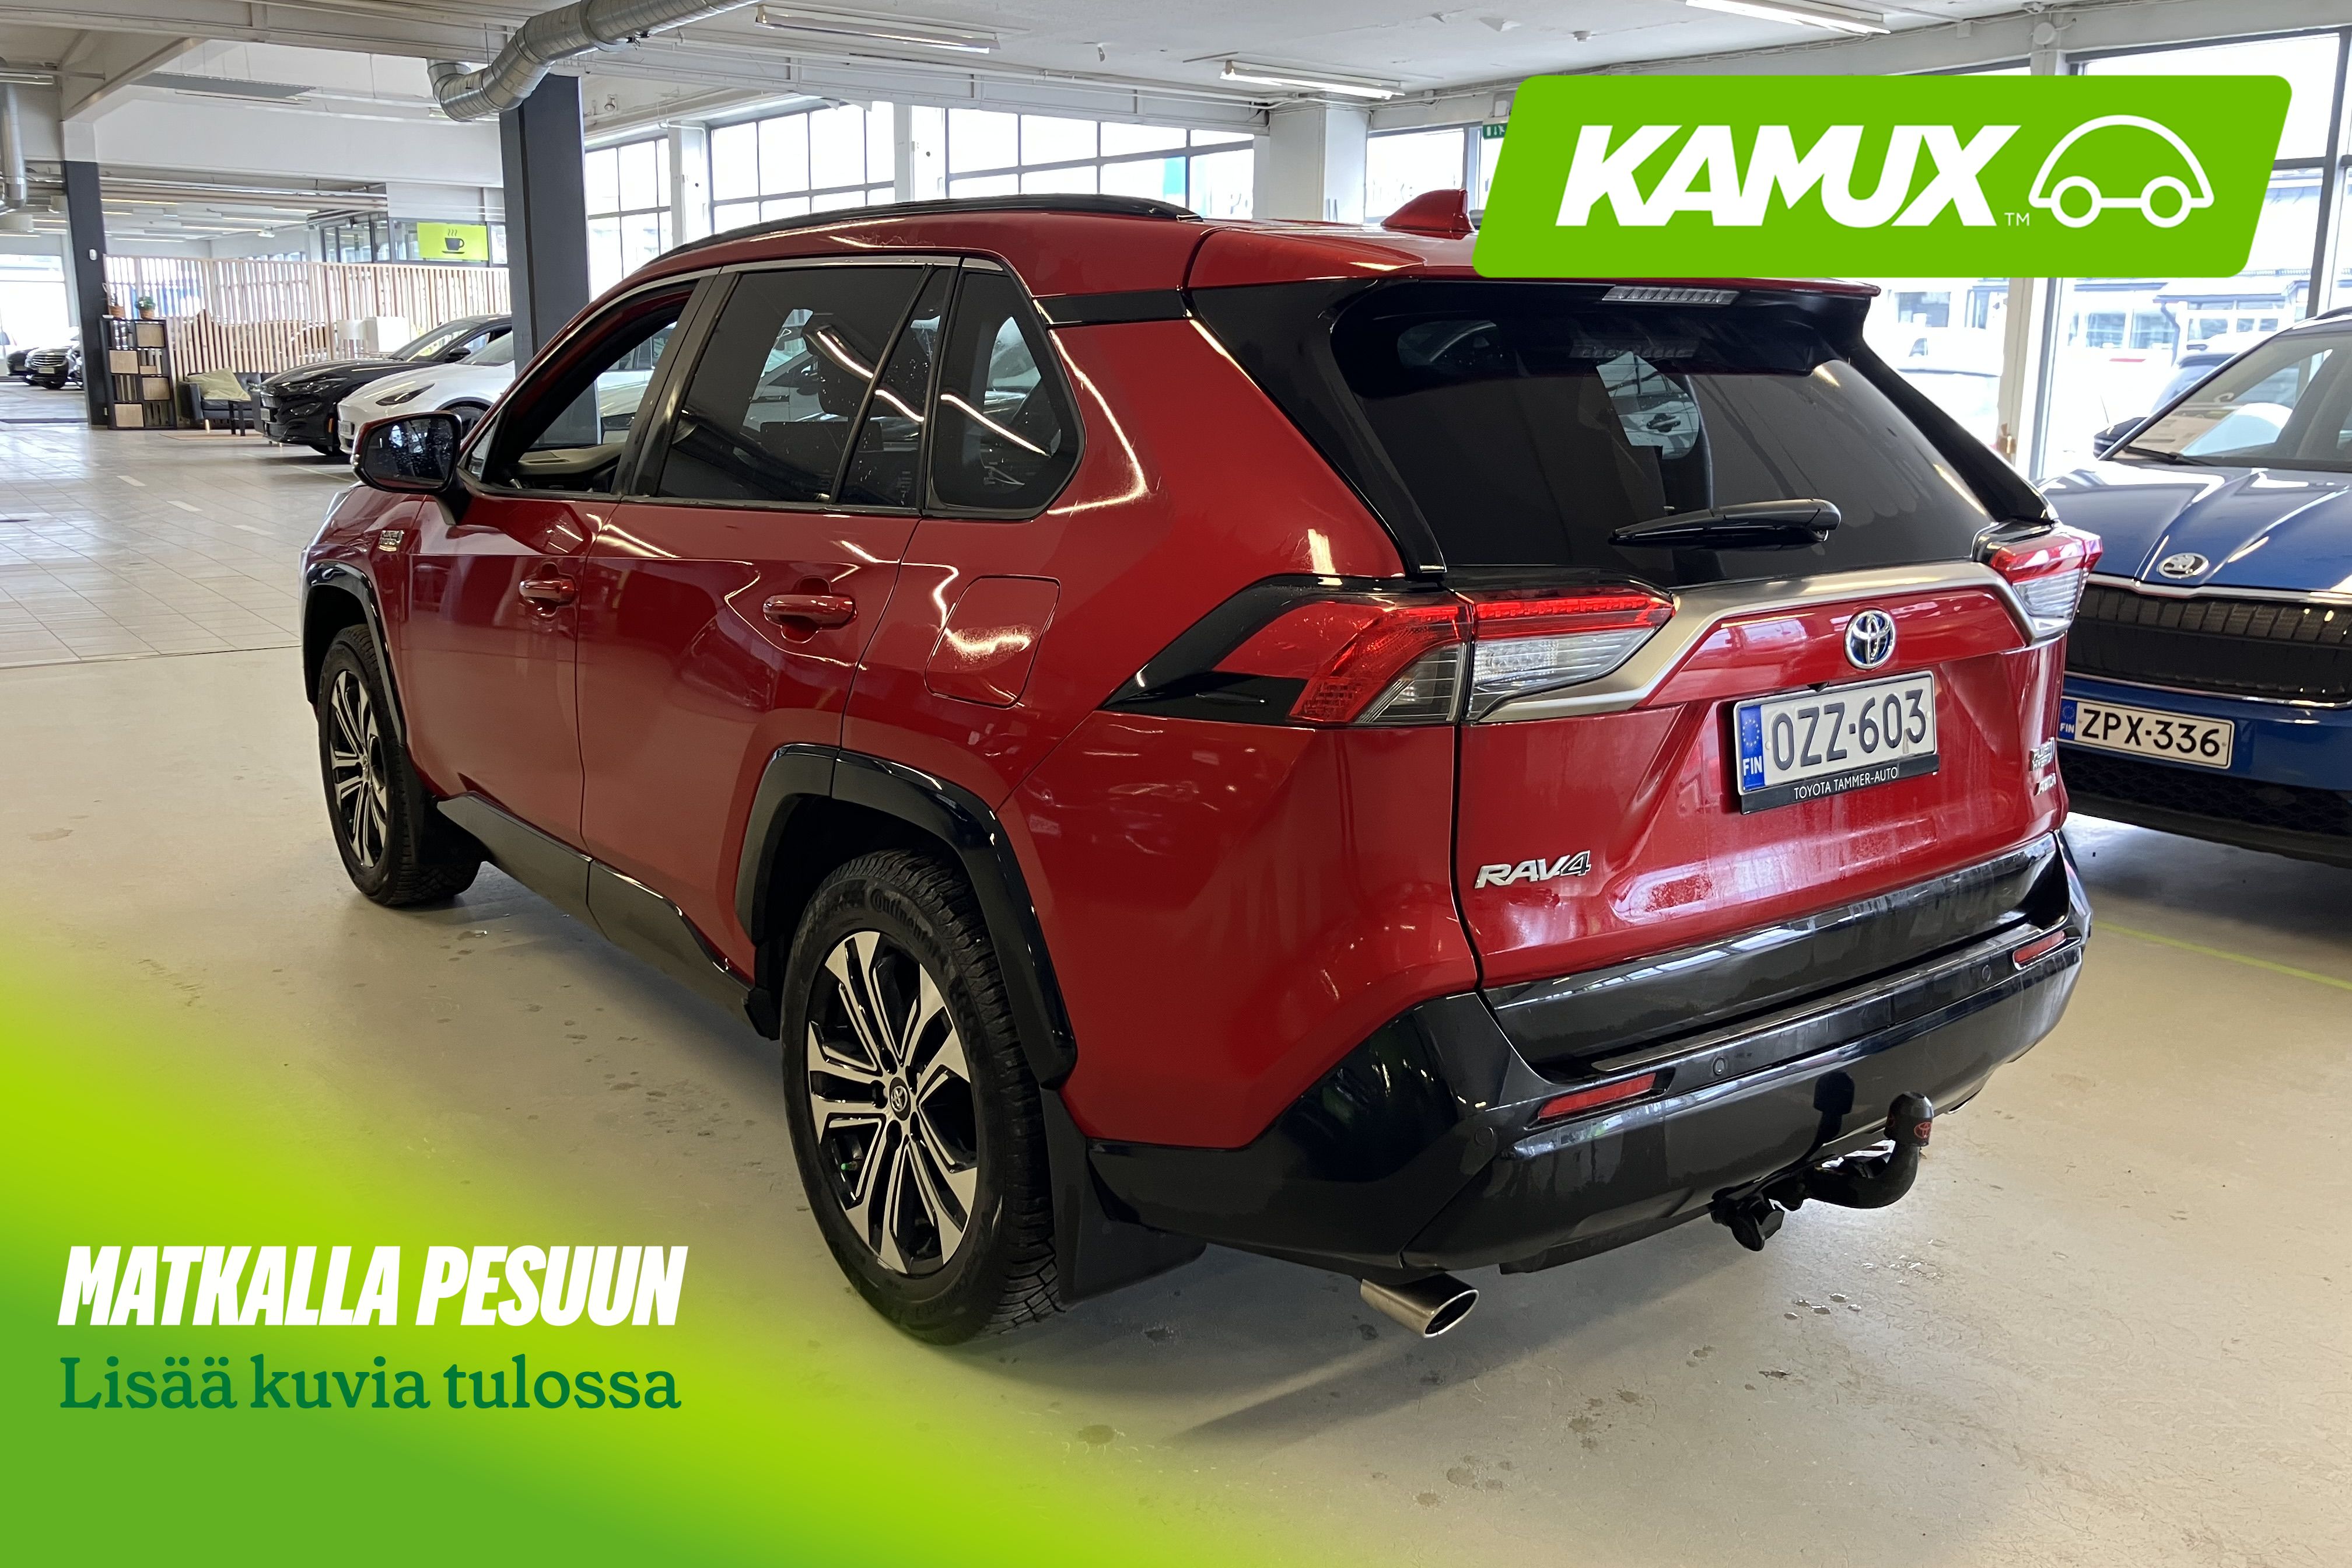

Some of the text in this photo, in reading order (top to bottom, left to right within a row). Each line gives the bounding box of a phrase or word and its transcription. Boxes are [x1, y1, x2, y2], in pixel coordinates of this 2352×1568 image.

[1772, 688, 1926, 771] OZZ-603
[2060, 722, 2075, 734] FIN
[2081, 708, 2220, 757] ZPX-336
[1742, 756, 1763, 776] FIN
[1794, 766, 1898, 800] TOYOTA TAMMER-AUTO
[1474, 849, 1591, 889] RAV4
